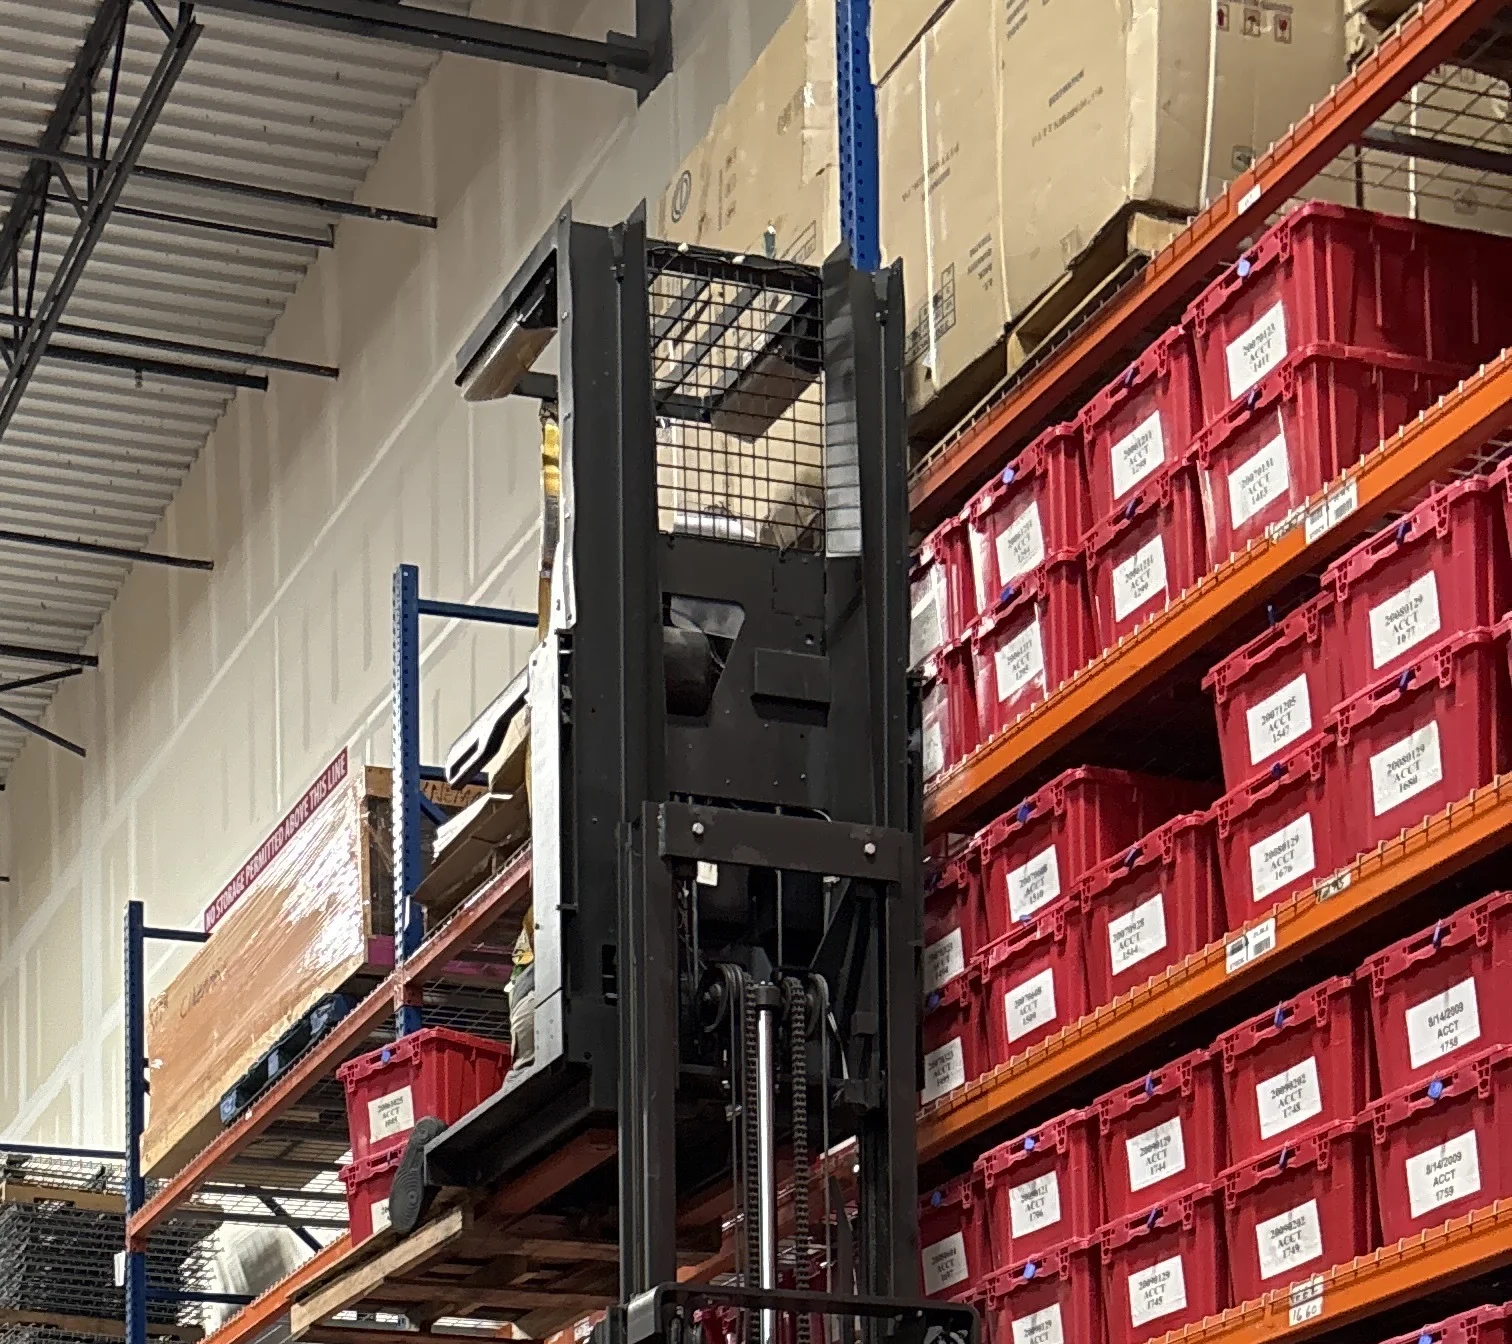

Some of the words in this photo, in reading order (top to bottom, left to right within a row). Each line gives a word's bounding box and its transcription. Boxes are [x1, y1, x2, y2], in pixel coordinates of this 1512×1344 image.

[1250, 342, 1272, 362] ACCT
[1248, 472, 1270, 494] ACCT
[1392, 610, 1419, 633] ACCT
[1268, 712, 1292, 733] ACCT
[1393, 760, 1420, 783] ACCT
[205, 907, 216, 930] NO
[216, 872, 245, 919] STORAGE
[245, 826, 284, 886] PERMITTED
[284, 795, 309, 840] ABOVE
[309, 774, 327, 810] THIS
[327, 752, 347, 790] LINE
[1270, 849, 1295, 870] ACCT
[1025, 878, 1045, 897] ACCT
[1118, 932, 1140, 951] ACCT
[1019, 999, 1038, 1016] ACCT
[1428, 1002, 1464, 1028] 8/14/2009
[1437, 1020, 1459, 1039] ACCT
[1278, 1090, 1302, 1108] ACCT
[1146, 1149, 1168, 1166] ACCT
[1426, 1151, 1462, 1175] 8/14/2009
[1433, 1169, 1456, 1187] ACCT
[1025, 1197, 1045, 1212] ACCT
[1277, 1231, 1302, 1248] ACCT
[1144, 1284, 1166, 1300] ACCT
